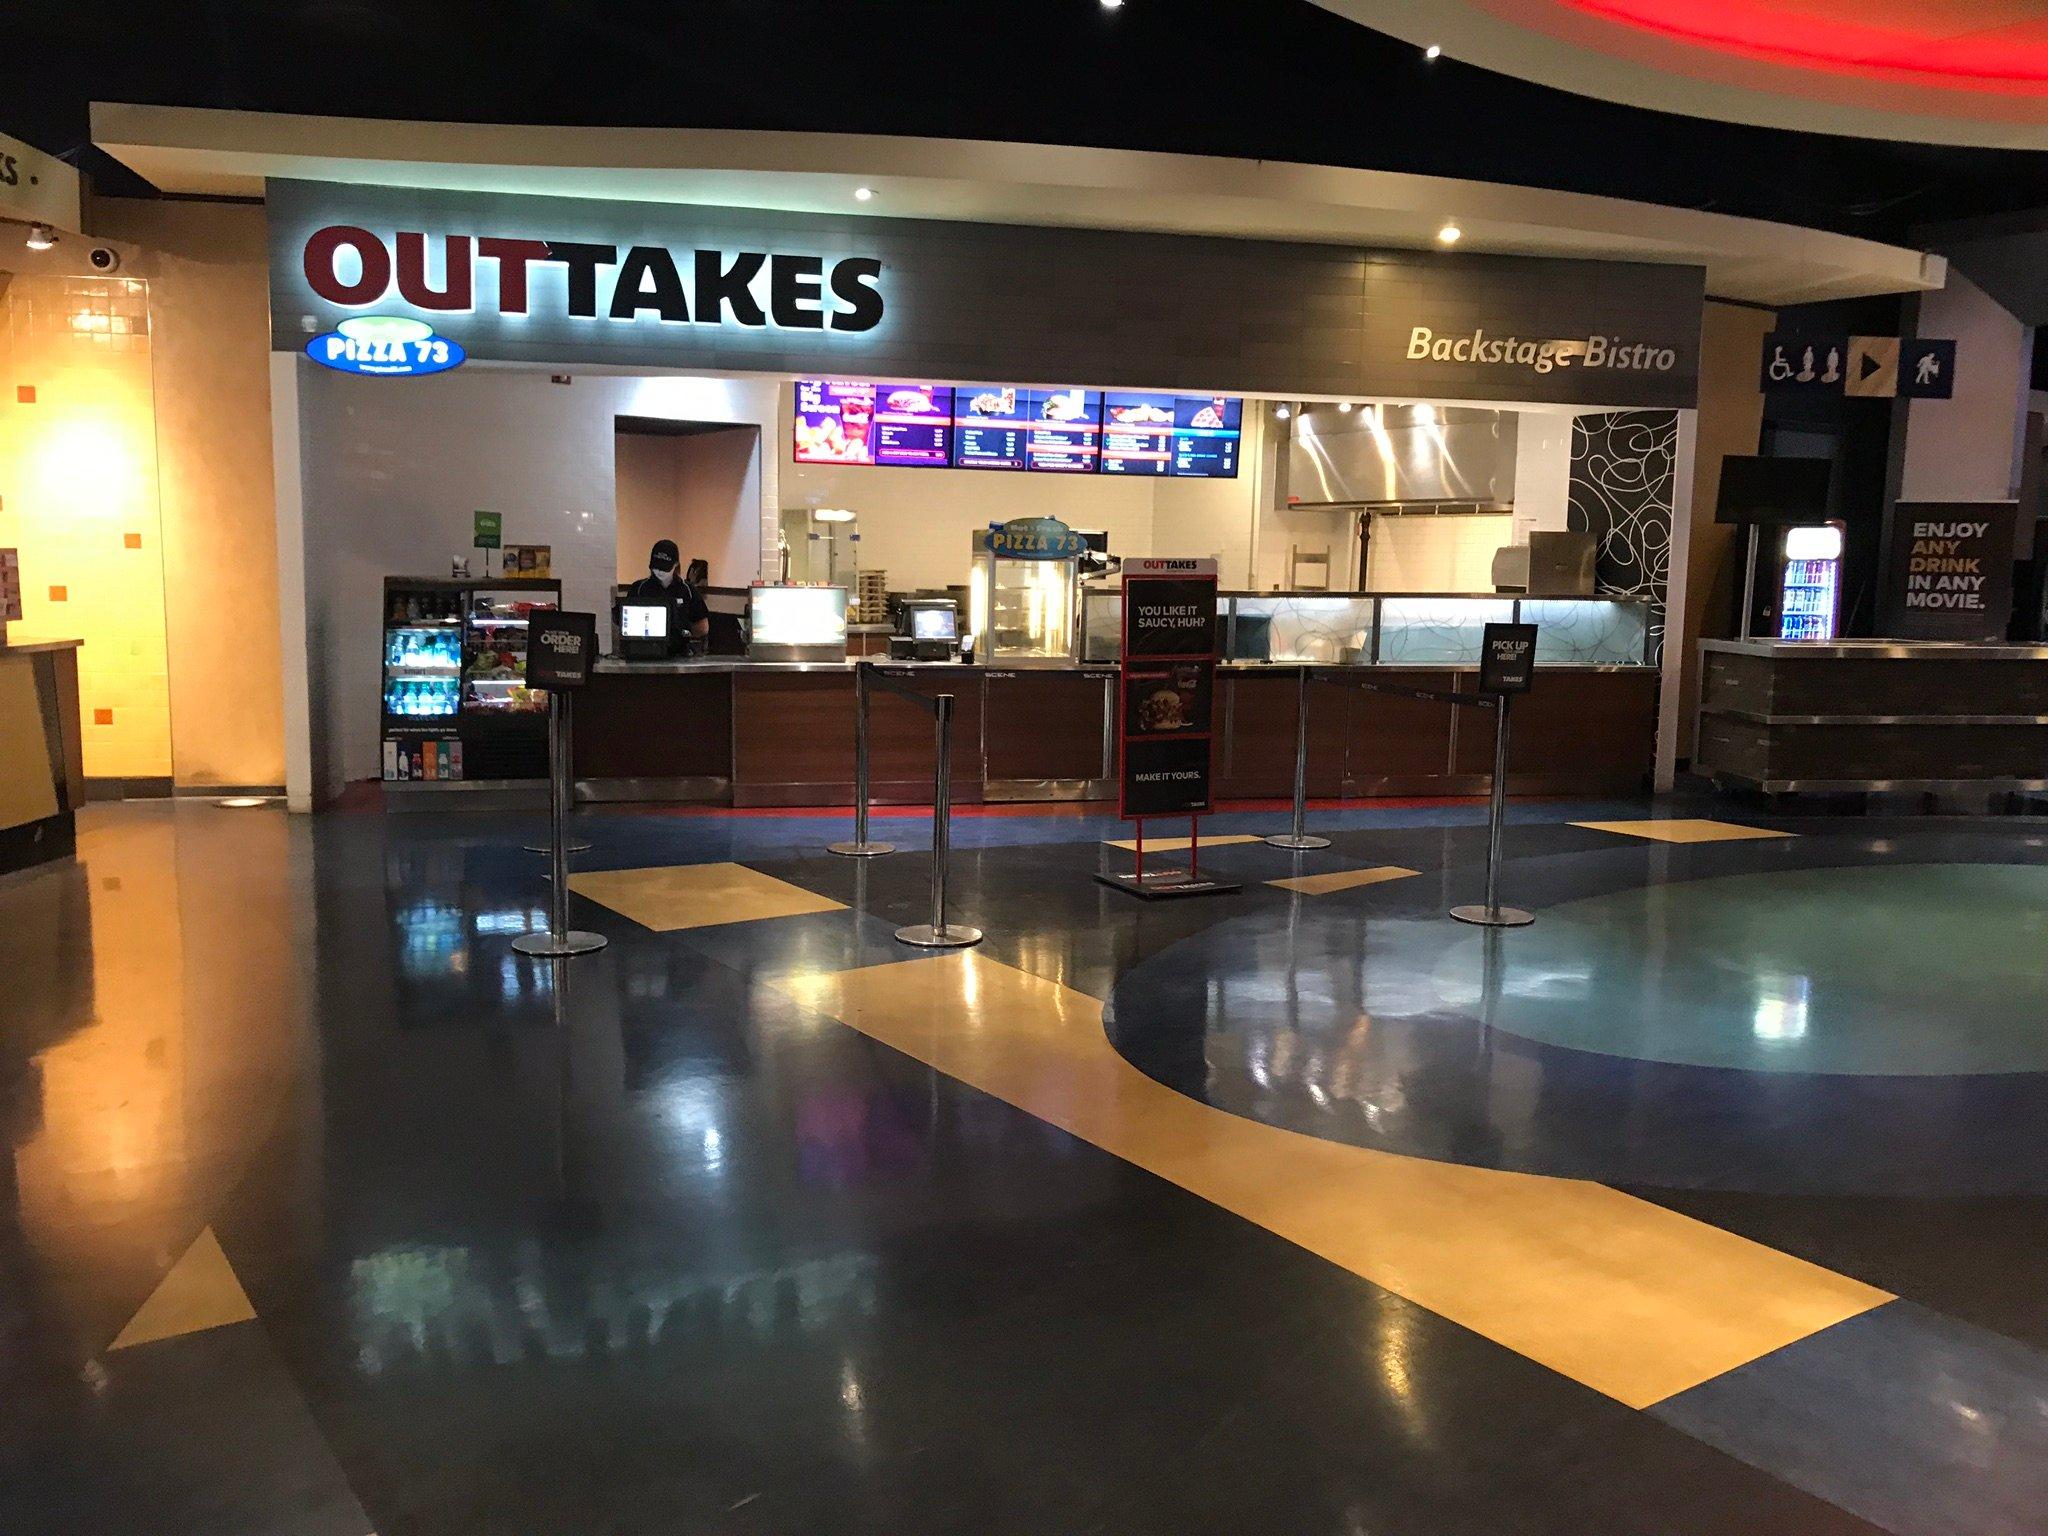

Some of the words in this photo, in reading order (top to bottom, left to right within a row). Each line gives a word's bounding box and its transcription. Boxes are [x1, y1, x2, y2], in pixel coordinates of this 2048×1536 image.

[303, 225, 885, 333] OUTTAKES
[326, 337, 408, 363] PIZZA
[414, 340, 449, 363] 73
[1406, 326, 1572, 374] Backstage
[1583, 335, 1676, 371] Bistro
[1913, 522, 1990, 538] ENJOY
[993, 533, 1048, 551] PIZZA
[1056, 534, 1078, 551] 73
[1910, 540, 1961, 555] ANY
[1143, 560, 1198, 570] OUTTAKES
[1909, 557, 1981, 574] DRINK
[1907, 575, 1932, 590] IN
[1935, 575, 1987, 591] ANY
[1906, 592, 1986, 610] MOVIE.
[1138, 606, 1161, 616] YOU
[1162, 606, 1187, 616] LIKE
[1188, 606, 1198, 616] IT
[1138, 617, 1176, 629] SAUCY,
[1177, 617, 1206, 628] HUH?
[540, 633, 582, 647] ORDER
[1492, 640, 1514, 650] PICK
[1515, 641, 1529, 650] UP
[1135, 772, 1161, 782] MAKE
[1162, 772, 1170, 781] IT
[1171, 771, 1202, 781] YOURS.
